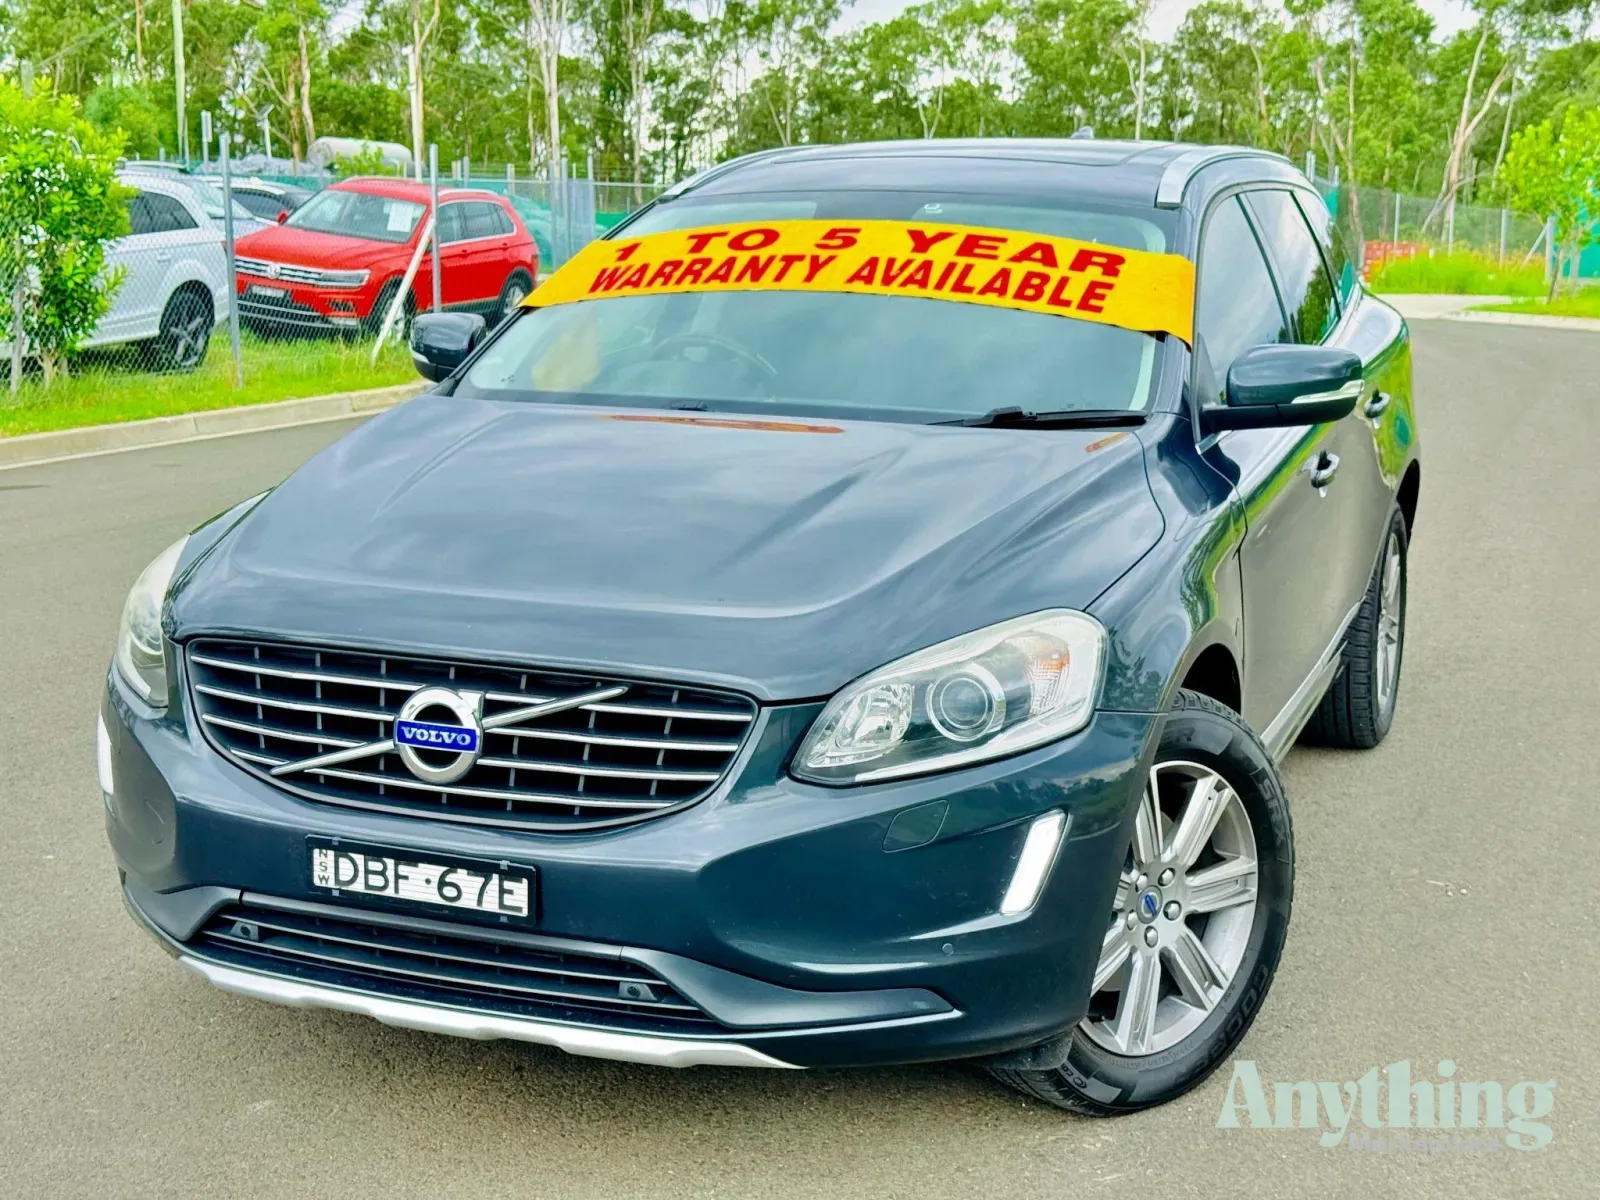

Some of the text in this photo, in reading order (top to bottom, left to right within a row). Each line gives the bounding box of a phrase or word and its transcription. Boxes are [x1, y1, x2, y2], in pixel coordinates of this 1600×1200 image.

[614, 228, 1125, 277] 1 TO 5 YEAR
[588, 254, 1114, 313] WARRANTY AVAILABLE
[401, 726, 471, 746] VOLVO
